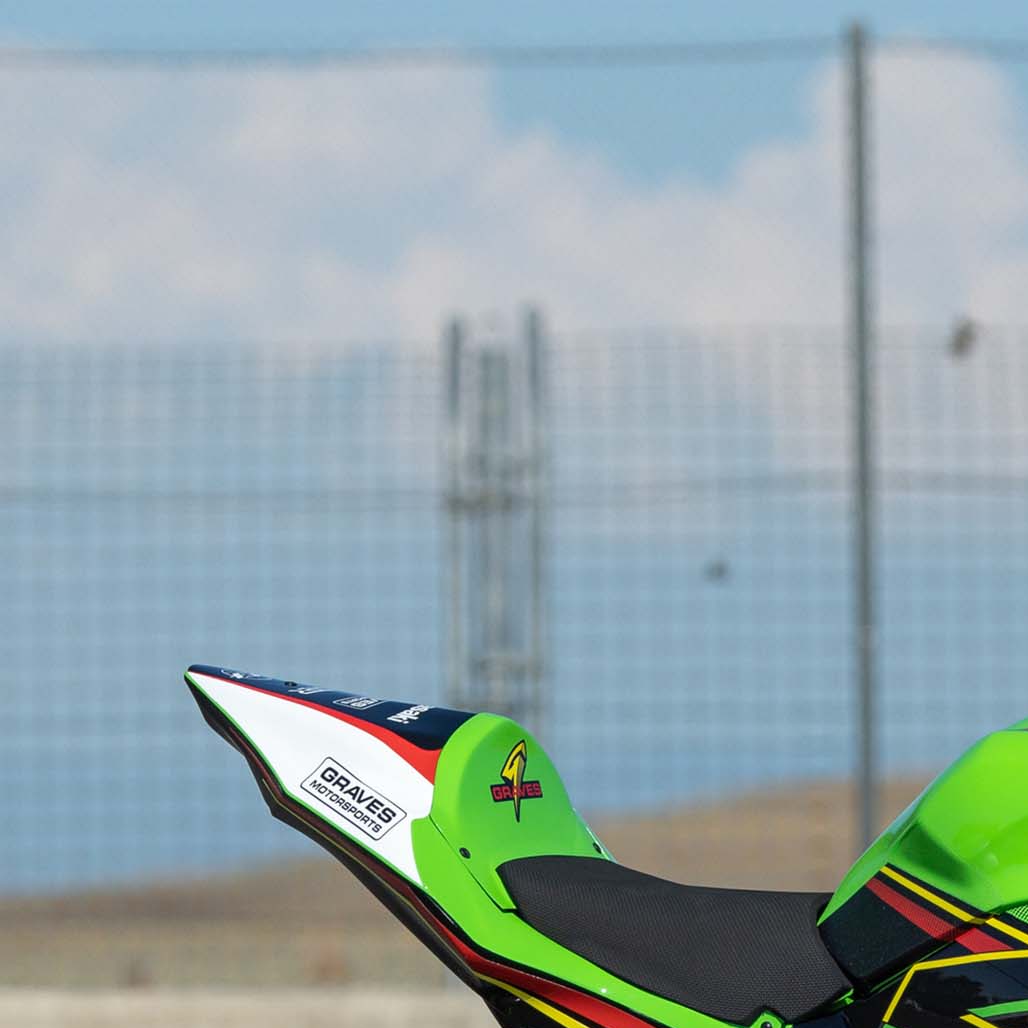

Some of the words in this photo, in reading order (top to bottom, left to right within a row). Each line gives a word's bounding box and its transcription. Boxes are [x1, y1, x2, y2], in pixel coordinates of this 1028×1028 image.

[309, 780, 383, 834] MOTORSPORTS
[320, 767, 396, 824] GRAVES
[492, 782, 542, 801] GRAVES
